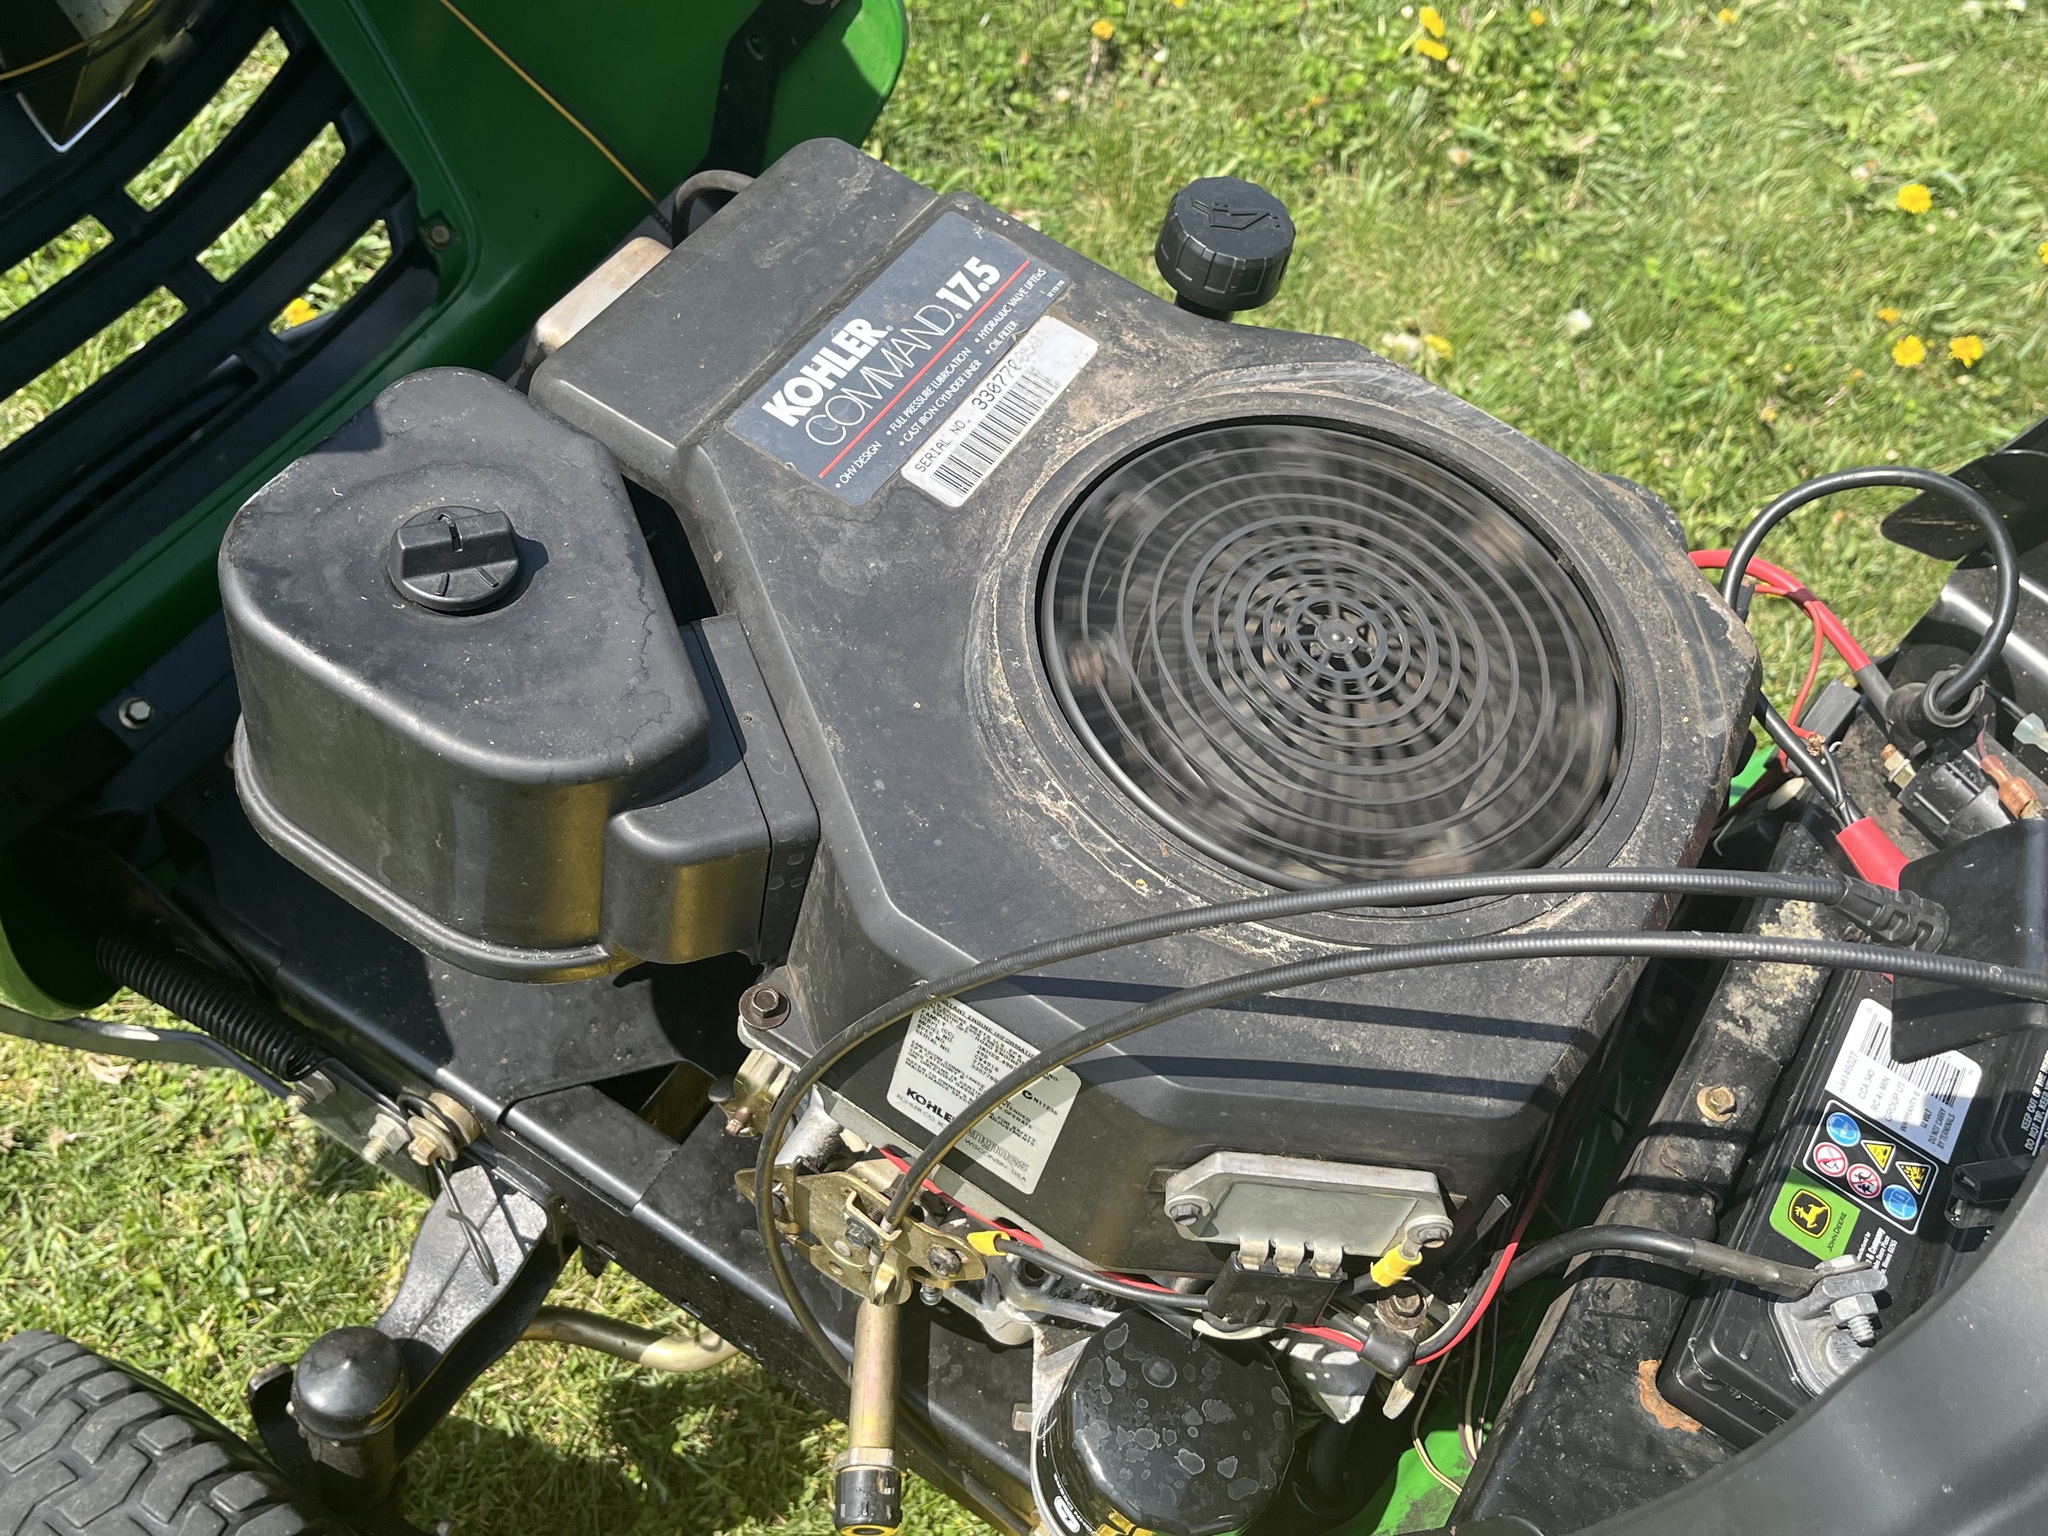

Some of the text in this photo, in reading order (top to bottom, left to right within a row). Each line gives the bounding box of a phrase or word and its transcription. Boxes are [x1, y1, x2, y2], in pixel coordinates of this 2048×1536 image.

[976, 303, 1012, 339] HYDRAULIC
[1006, 286, 1028, 307] VALVE
[805, 256, 1000, 445] COMMAND 17.5
[987, 319, 1018, 351] OIL FILTER
[762, 318, 888, 427] KOHLER
[889, 346, 972, 432] FULL PRESSURE LUBRICATION
[901, 358, 982, 442] CAST IRON CYLINDER LINER
[913, 435, 952, 473] SERIAL
[948, 414, 971, 436] NO.
[837, 439, 882, 485] OHV DESIGN
[921, 1009, 945, 1027] FAMILY
[967, 1014, 993, 1033] ENGINE
[914, 1028, 938, 1045] SERIAL
[1858, 1069, 1875, 1099] CCA 340
[1870, 1100, 1880, 1112] RC
[1880, 1075, 1890, 1091] MIN
[2032, 1085, 2041, 1098] OF
[2035, 1072, 2047, 1087] THE
[905, 1087, 955, 1124] KOHLE
[1884, 1092, 1899, 1122] GROUP
[1900, 1097, 1917, 1132] WARRANTY
[2027, 1097, 2038, 1113] OUT
[2033, 1110, 2045, 1123] TIP.
[1927, 1134, 1936, 1145] DO
[1935, 1107, 1947, 1126] CARRY
[2020, 1112, 2032, 1132] KEEP
[2029, 1122, 2040, 1139] NOT
[2024, 1138, 2035, 1150] DO
[1827, 1212, 1847, 1252] JOHN DEERE
[1868, 1227, 1886, 1255] Company
